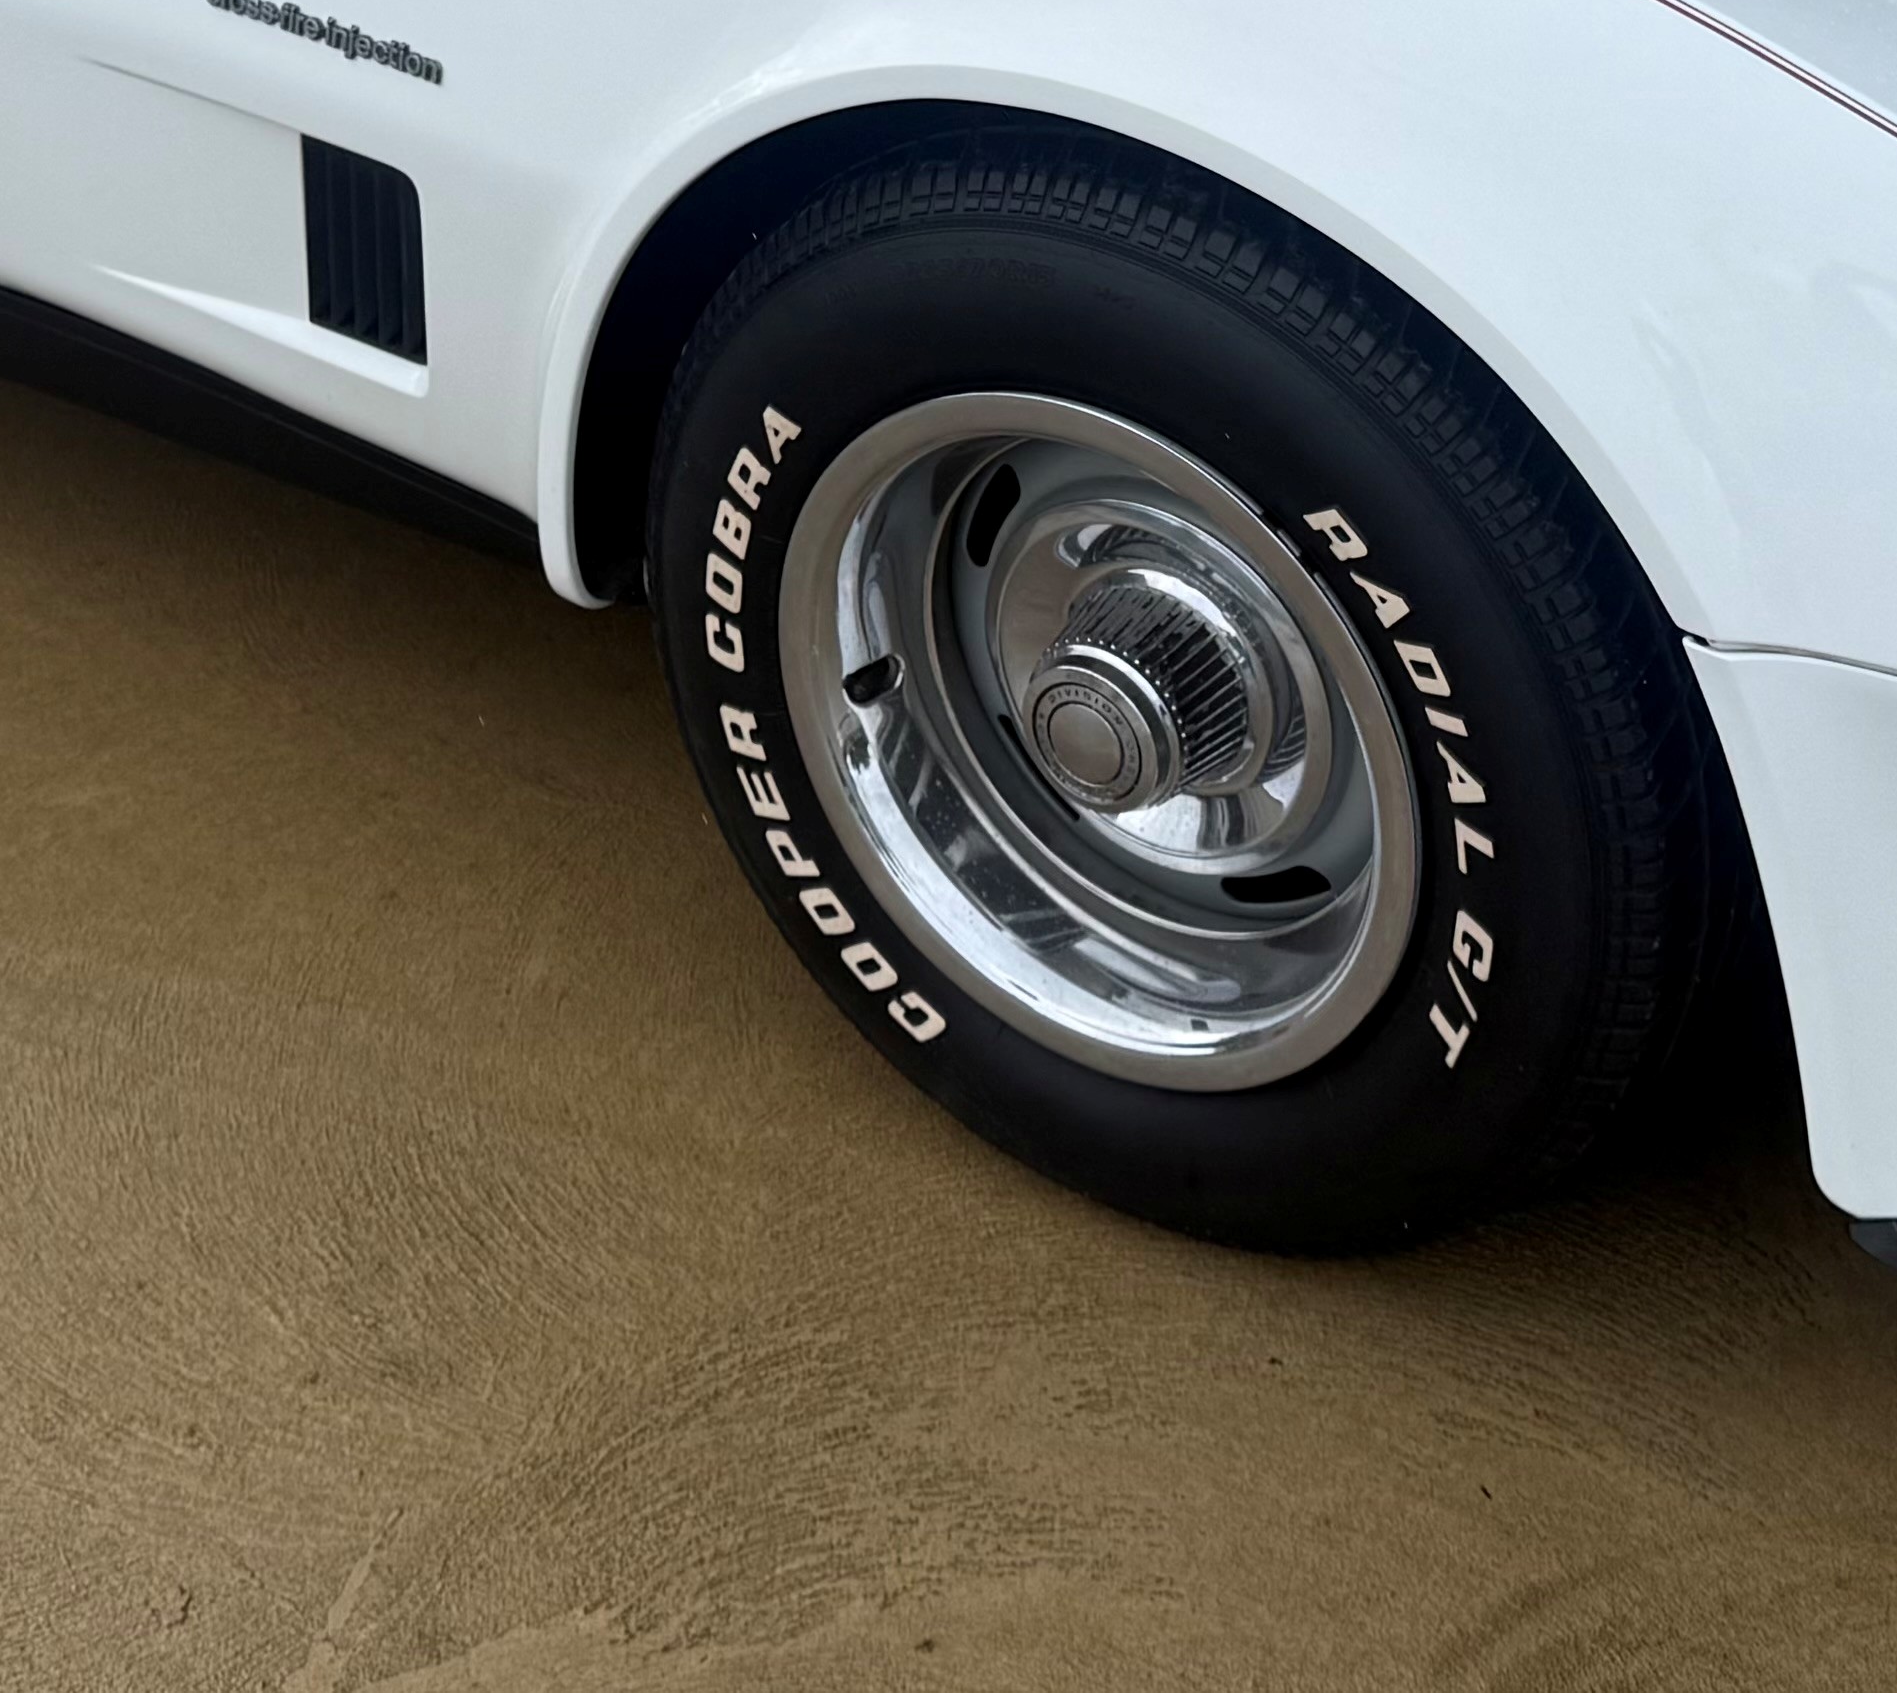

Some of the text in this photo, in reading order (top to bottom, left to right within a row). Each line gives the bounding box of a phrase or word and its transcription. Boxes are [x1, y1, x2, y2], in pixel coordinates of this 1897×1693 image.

[325, 16, 444, 85] injection
[705, 406, 946, 1042] COOPER COBRA
[1303, 508, 1494, 1068] RADIAL G/T
